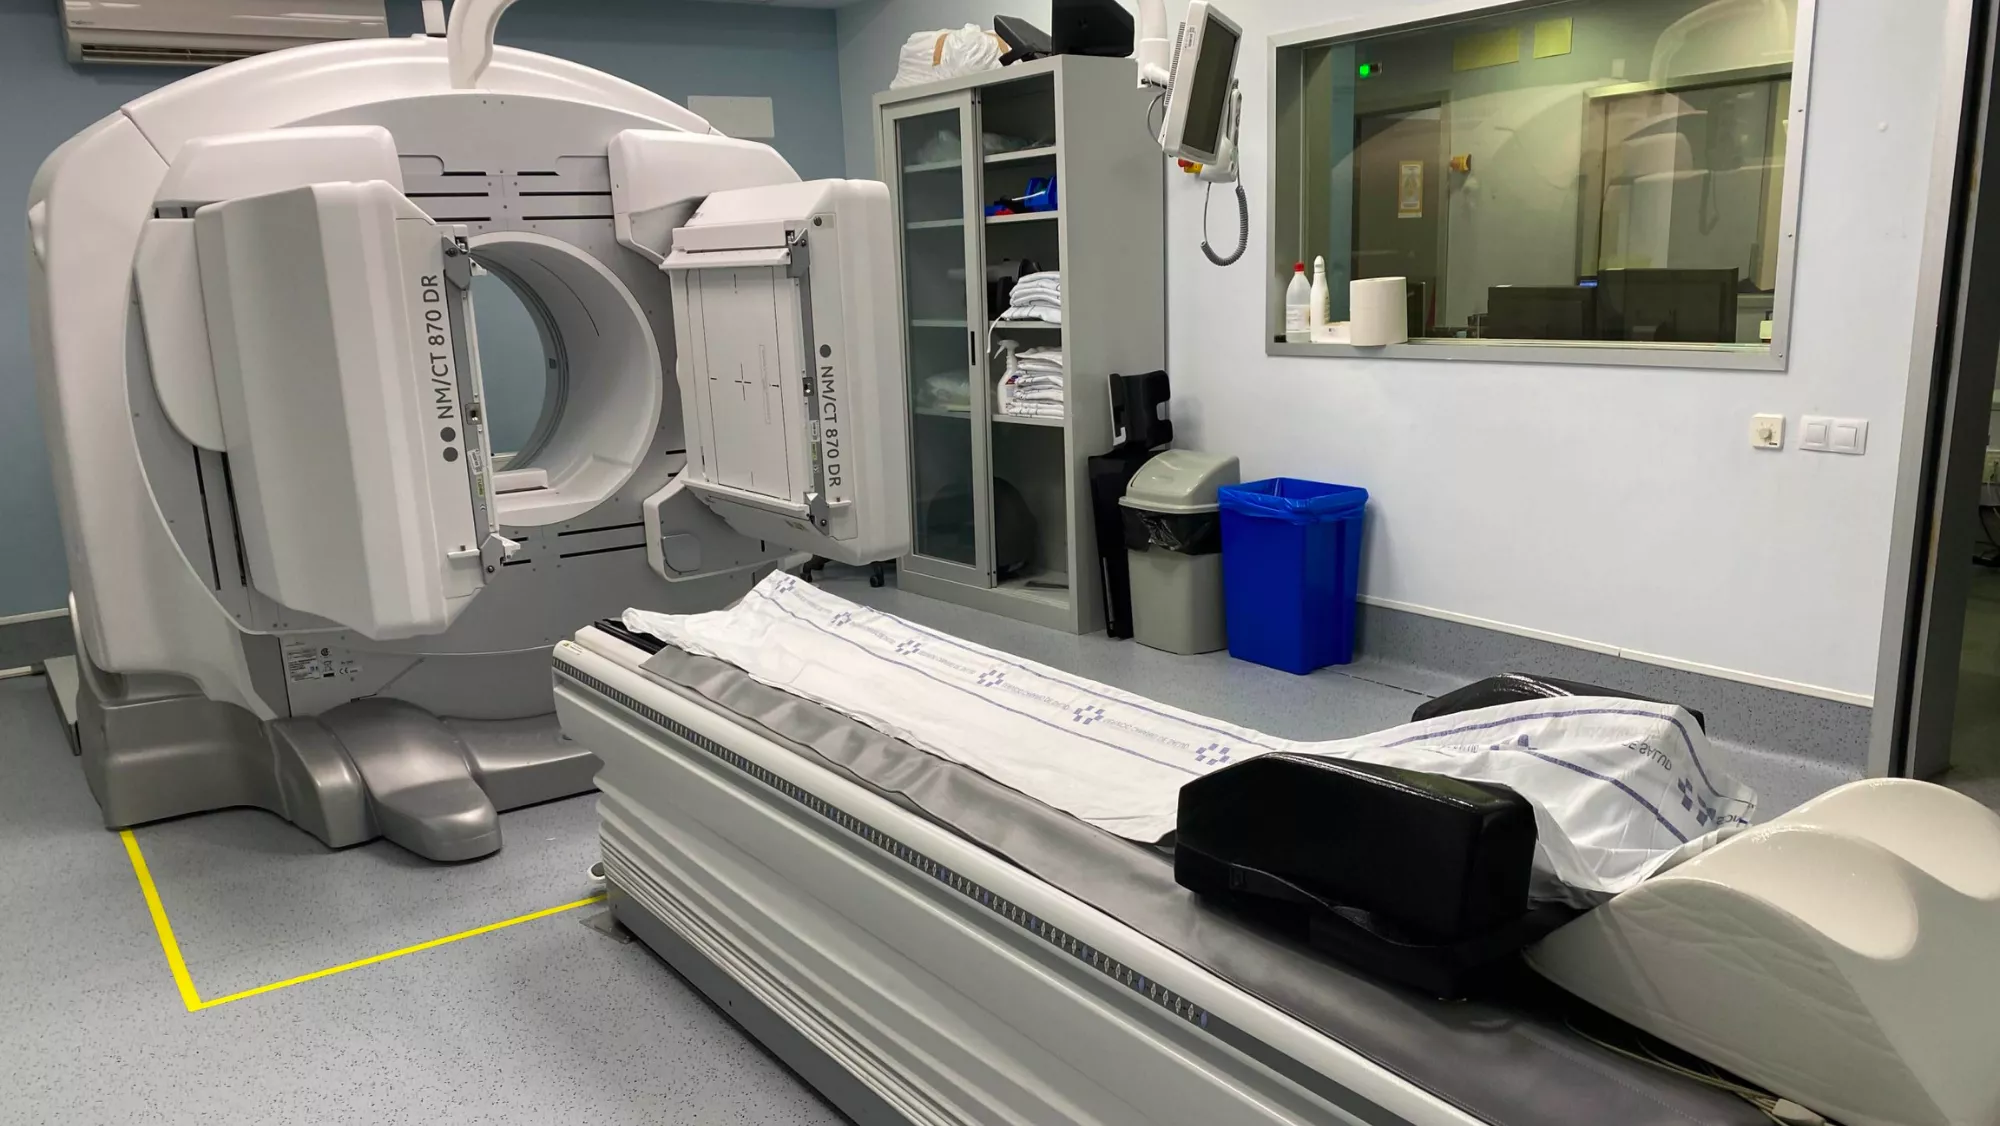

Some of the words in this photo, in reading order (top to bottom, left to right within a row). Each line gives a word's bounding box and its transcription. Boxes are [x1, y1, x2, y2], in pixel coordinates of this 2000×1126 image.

[421, 274, 440, 303] DR
[425, 309, 445, 346] 870
[430, 352, 454, 420] NM/CT
[820, 365, 838, 424] NM/CT
[825, 428, 840, 459] 870
[828, 463, 842, 488] DR
